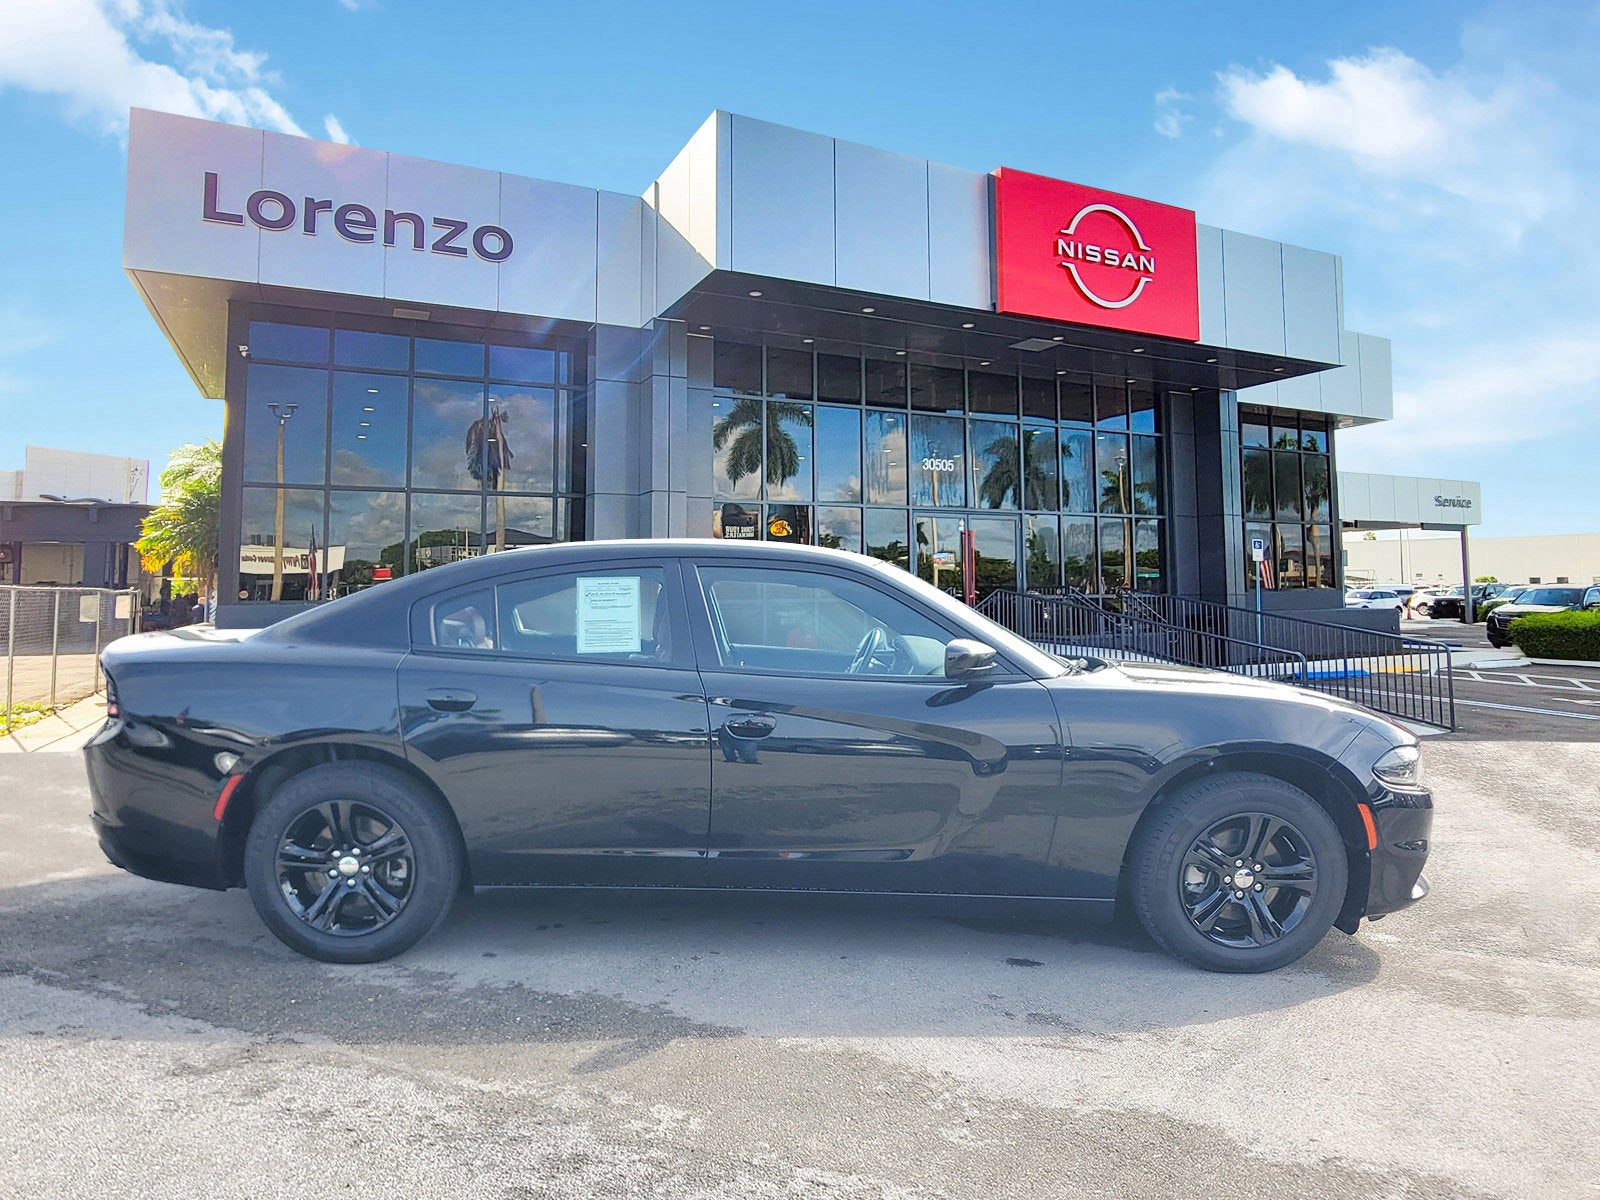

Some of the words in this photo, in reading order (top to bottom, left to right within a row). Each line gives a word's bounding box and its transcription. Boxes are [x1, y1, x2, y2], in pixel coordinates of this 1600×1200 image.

[202, 171, 514, 262] Lorenzo
[1057, 238, 1155, 273] NISSAN
[922, 457, 955, 472] 30505
[1434, 495, 1472, 509] Service
